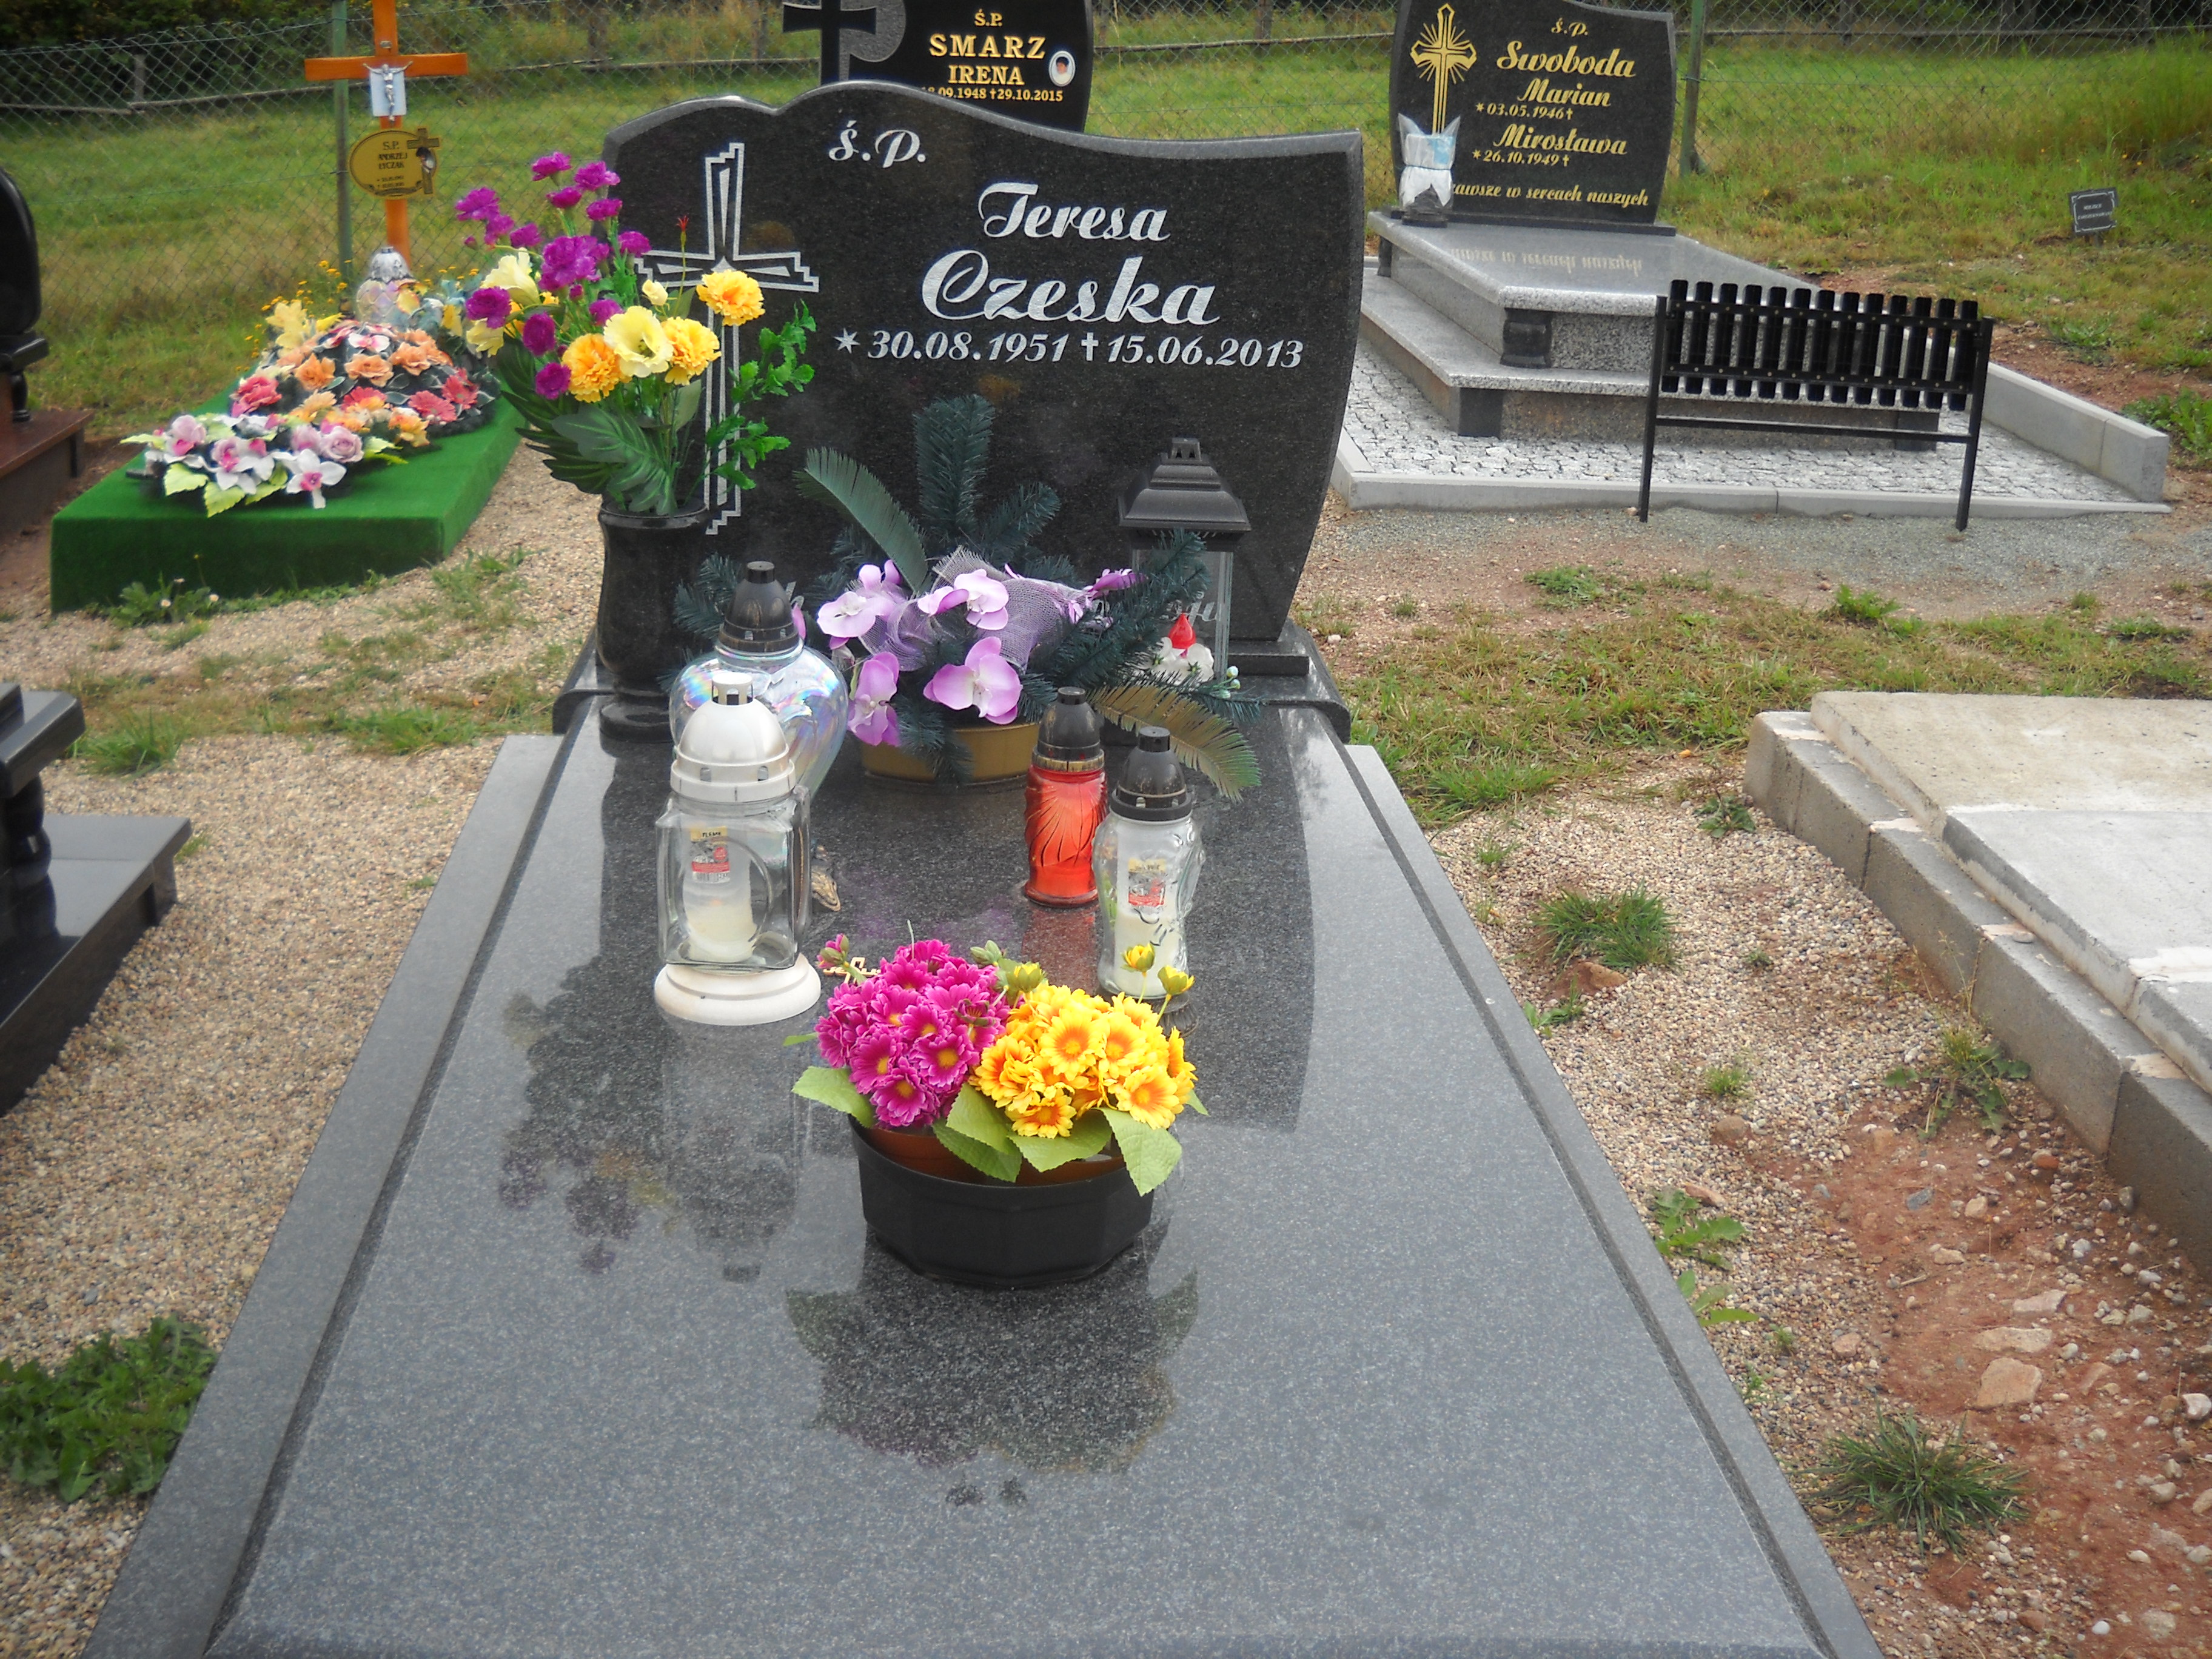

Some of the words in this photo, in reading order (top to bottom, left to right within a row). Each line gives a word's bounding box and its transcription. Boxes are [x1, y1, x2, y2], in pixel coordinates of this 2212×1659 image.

[974, 8, 1003, 27] Ś.P.
[929, 33, 1046, 59] SMARZ
[1496, 40, 1637, 78] Swoboda
[948, 64, 1025, 86] IRENA
[1517, 78, 1611, 107] Marian
[1487, 102, 1565, 119] 03.05.1946
[1493, 123, 1628, 156] Mirosława
[1483, 150, 1560, 166] 26.10.1949
[1453, 184, 1501, 197] awsze
[1506, 187, 1521, 198] w
[1526, 185, 1582, 202] sercach
[1586, 189, 1649, 209] naszych
[977, 182, 1171, 241] Teresa
[922, 249, 1221, 325] Czeska
[867, 330, 1070, 363] 30.08.1951
[1108, 334, 1304, 368] 15.06.2013
